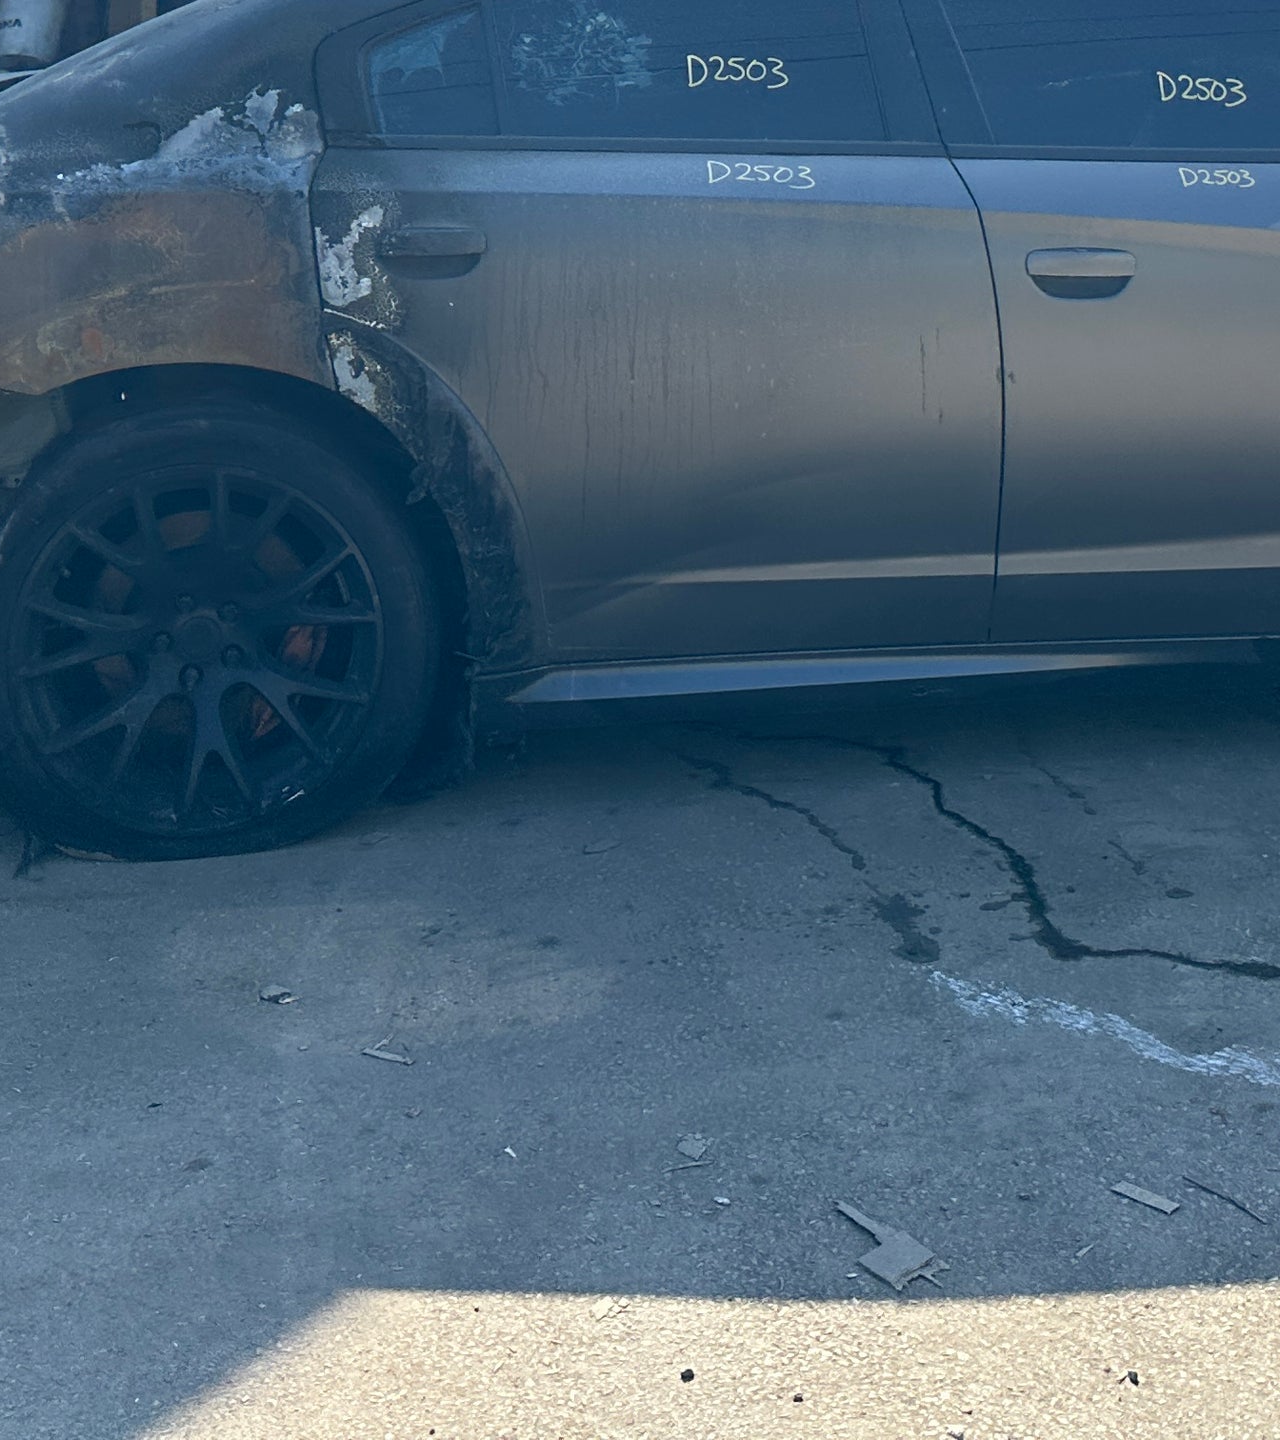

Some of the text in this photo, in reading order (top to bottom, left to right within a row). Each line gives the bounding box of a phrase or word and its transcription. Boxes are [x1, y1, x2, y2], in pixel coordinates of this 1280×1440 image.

[687, 54, 789, 88] D2503
[1156, 71, 1247, 107] D2503
[707, 160, 816, 189] D2503
[1178, 167, 1255, 188] D2503
